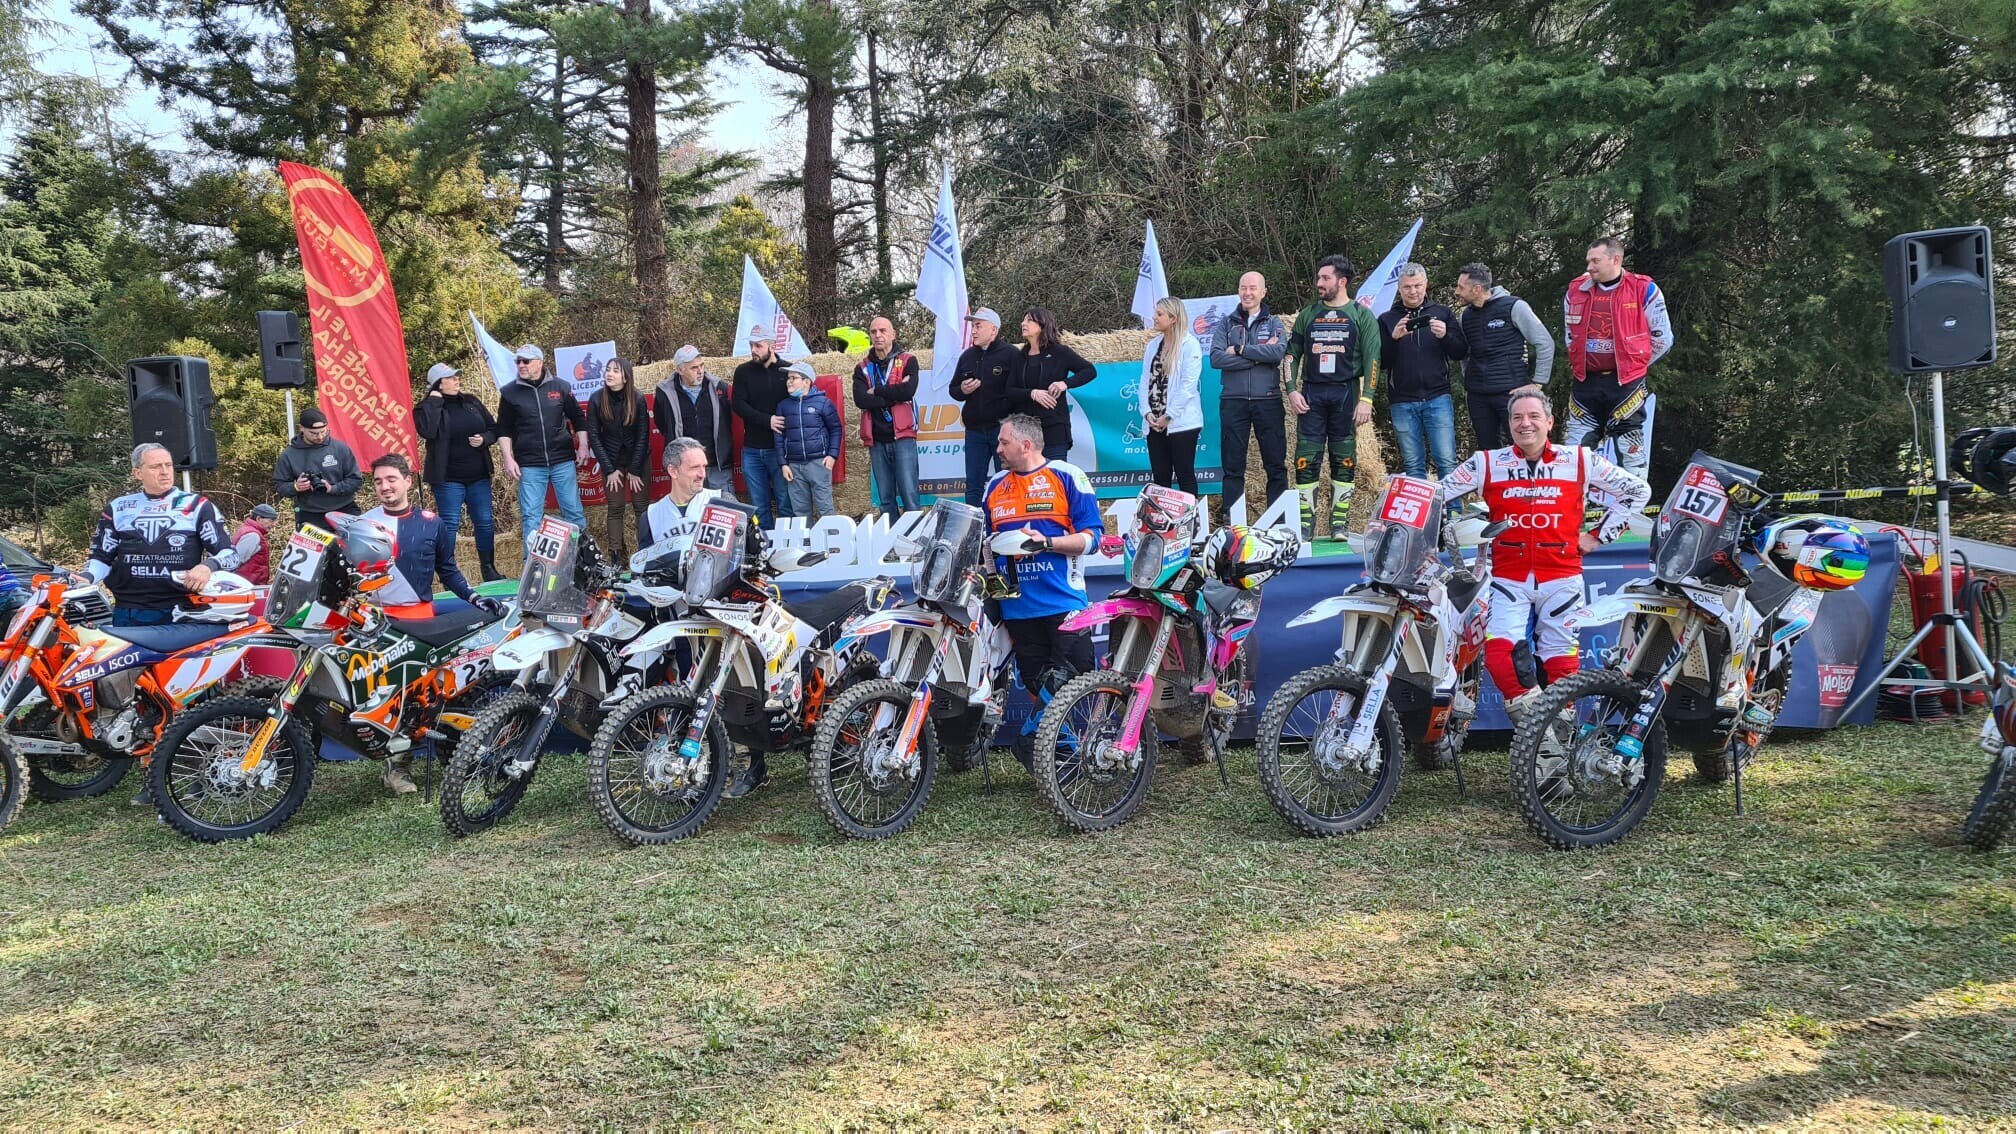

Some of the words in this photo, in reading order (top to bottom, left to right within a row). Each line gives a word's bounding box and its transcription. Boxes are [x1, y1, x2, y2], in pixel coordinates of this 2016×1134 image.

[1613, 388, 1645, 419] CIRCUIT
[1090, 470, 1127, 484] ccessori
[1507, 466, 1555, 481] KENNY
[1403, 484, 1430, 497] MOTUL
[1502, 486, 1563, 499] ORIGINAL
[1782, 491, 1820, 502] Nikon
[1844, 488, 1883, 499] Nikon
[1908, 485, 1937, 496] Niko
[1387, 496, 1423, 523] 55
[1678, 487, 1723, 518] 157
[710, 513, 734, 525] MOTUL
[304, 526, 329, 543] Nikon
[698, 525, 727, 549] 156
[532, 535, 561, 560] 146
[131, 565, 171, 577] SELLA
[1639, 604, 1667, 614] Nikon
[684, 627, 710, 635] Nikon
[108, 652, 140, 671] ISCOT
[352, 640, 416, 681] McDonald's
[74, 664, 106, 682] SELLA
[462, 658, 491, 687] 22
[1363, 688, 1382, 720] SELLA
